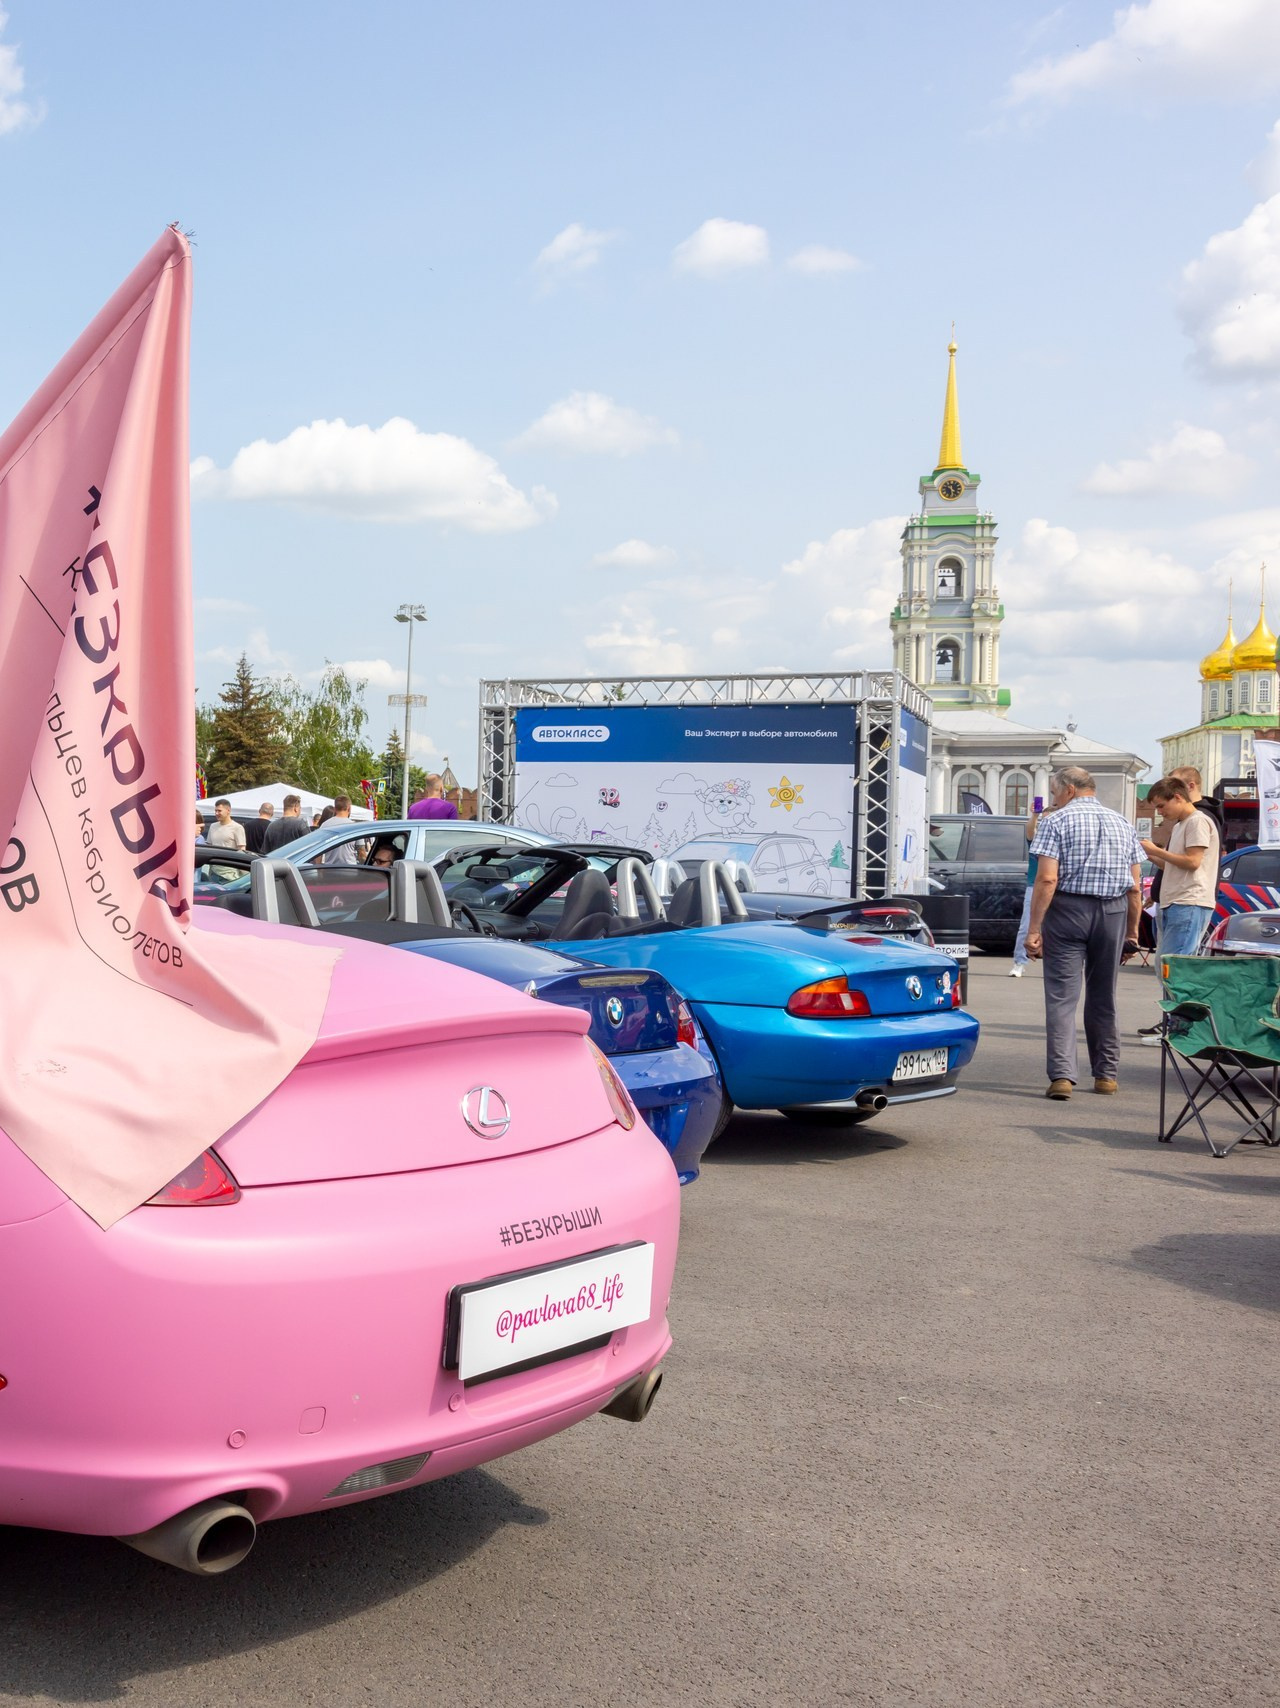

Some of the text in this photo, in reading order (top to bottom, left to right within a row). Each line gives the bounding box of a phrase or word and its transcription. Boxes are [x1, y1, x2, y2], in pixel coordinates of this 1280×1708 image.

[538, 729, 603, 738] АВТОКЛАСС
[684, 729, 703, 737] Ваш
[704, 729, 740, 739] Эксперт
[748, 729, 783, 739] выборе
[783, 729, 838, 738] автомобиля
[77, 807, 184, 968] кабриолетов
[499, 1206, 602, 1247] #БЕЗКРЫШИ
[496, 1273, 624, 1343] @pavlova68_life
